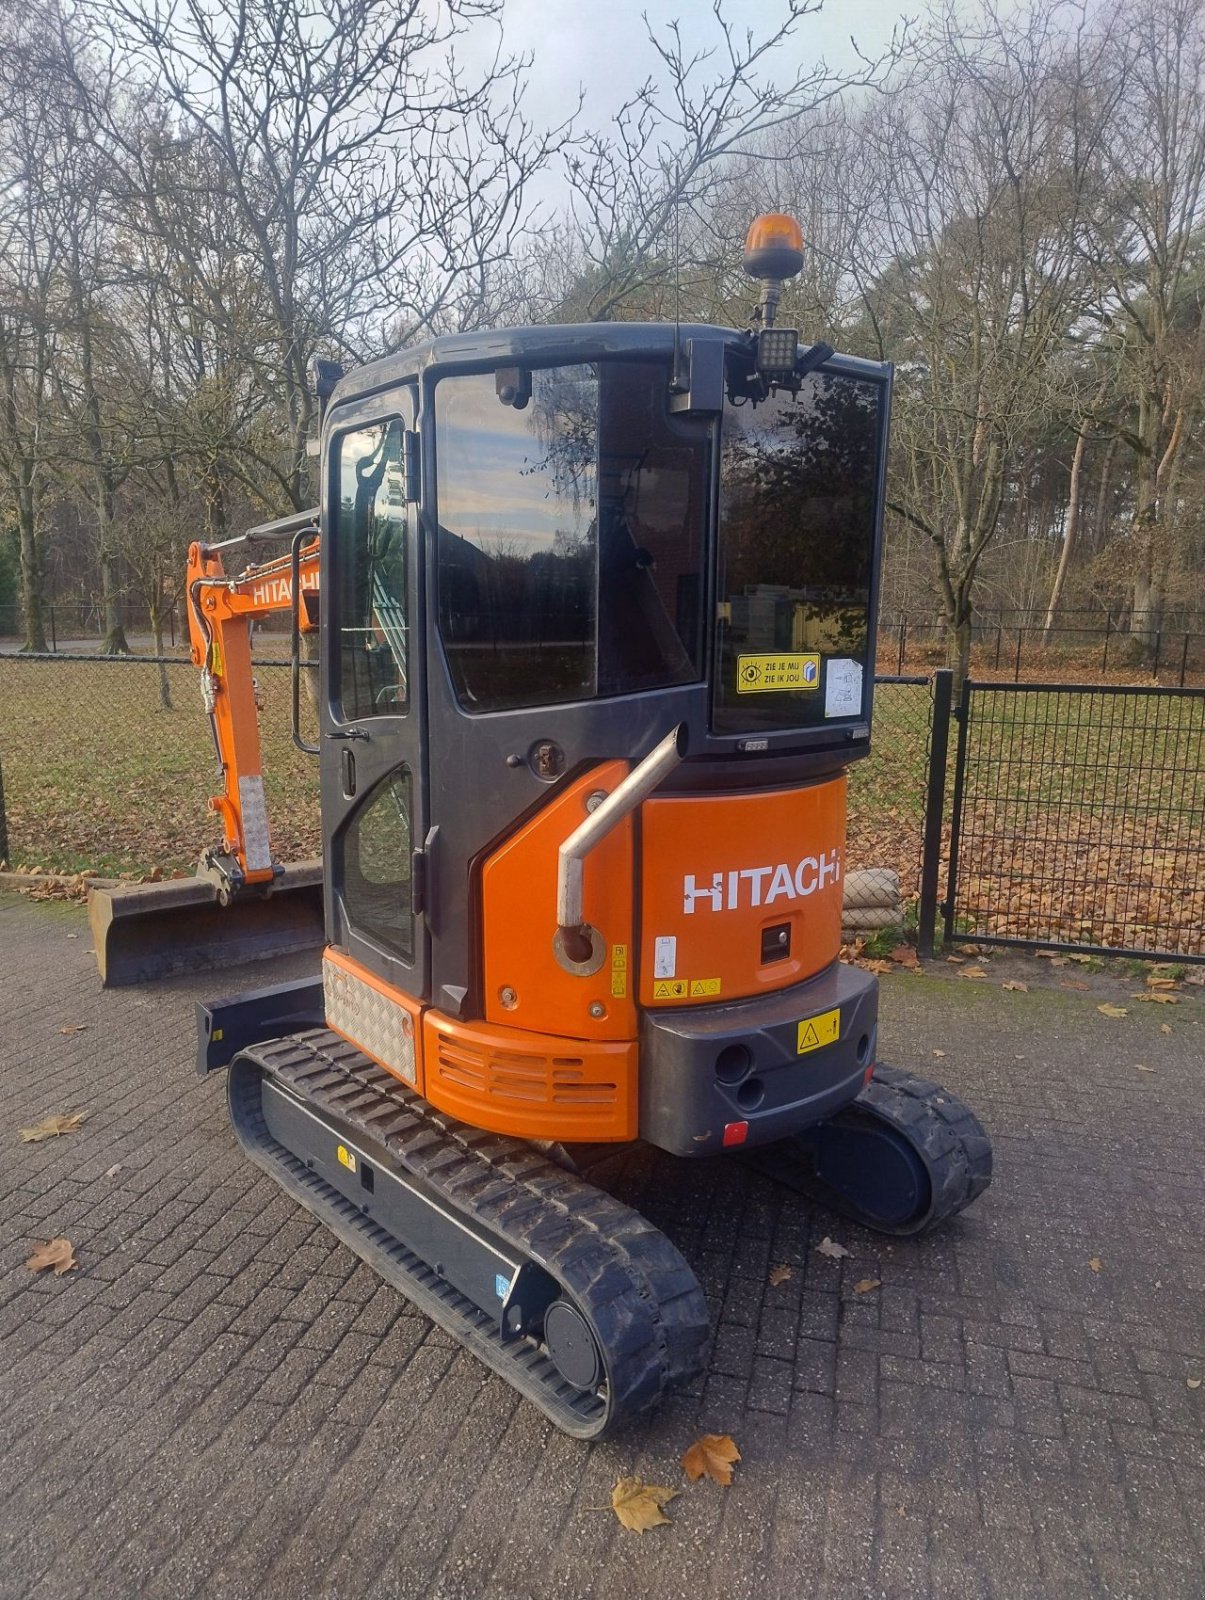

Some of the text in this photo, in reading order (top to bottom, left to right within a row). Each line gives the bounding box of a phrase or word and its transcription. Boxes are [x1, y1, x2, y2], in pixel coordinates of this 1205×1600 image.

[765, 662, 777, 671] ZIE
[778, 662, 785, 671] JE
[764, 674, 800, 683] ZIE IK JOU
[683, 847, 841, 915] HITACHI
